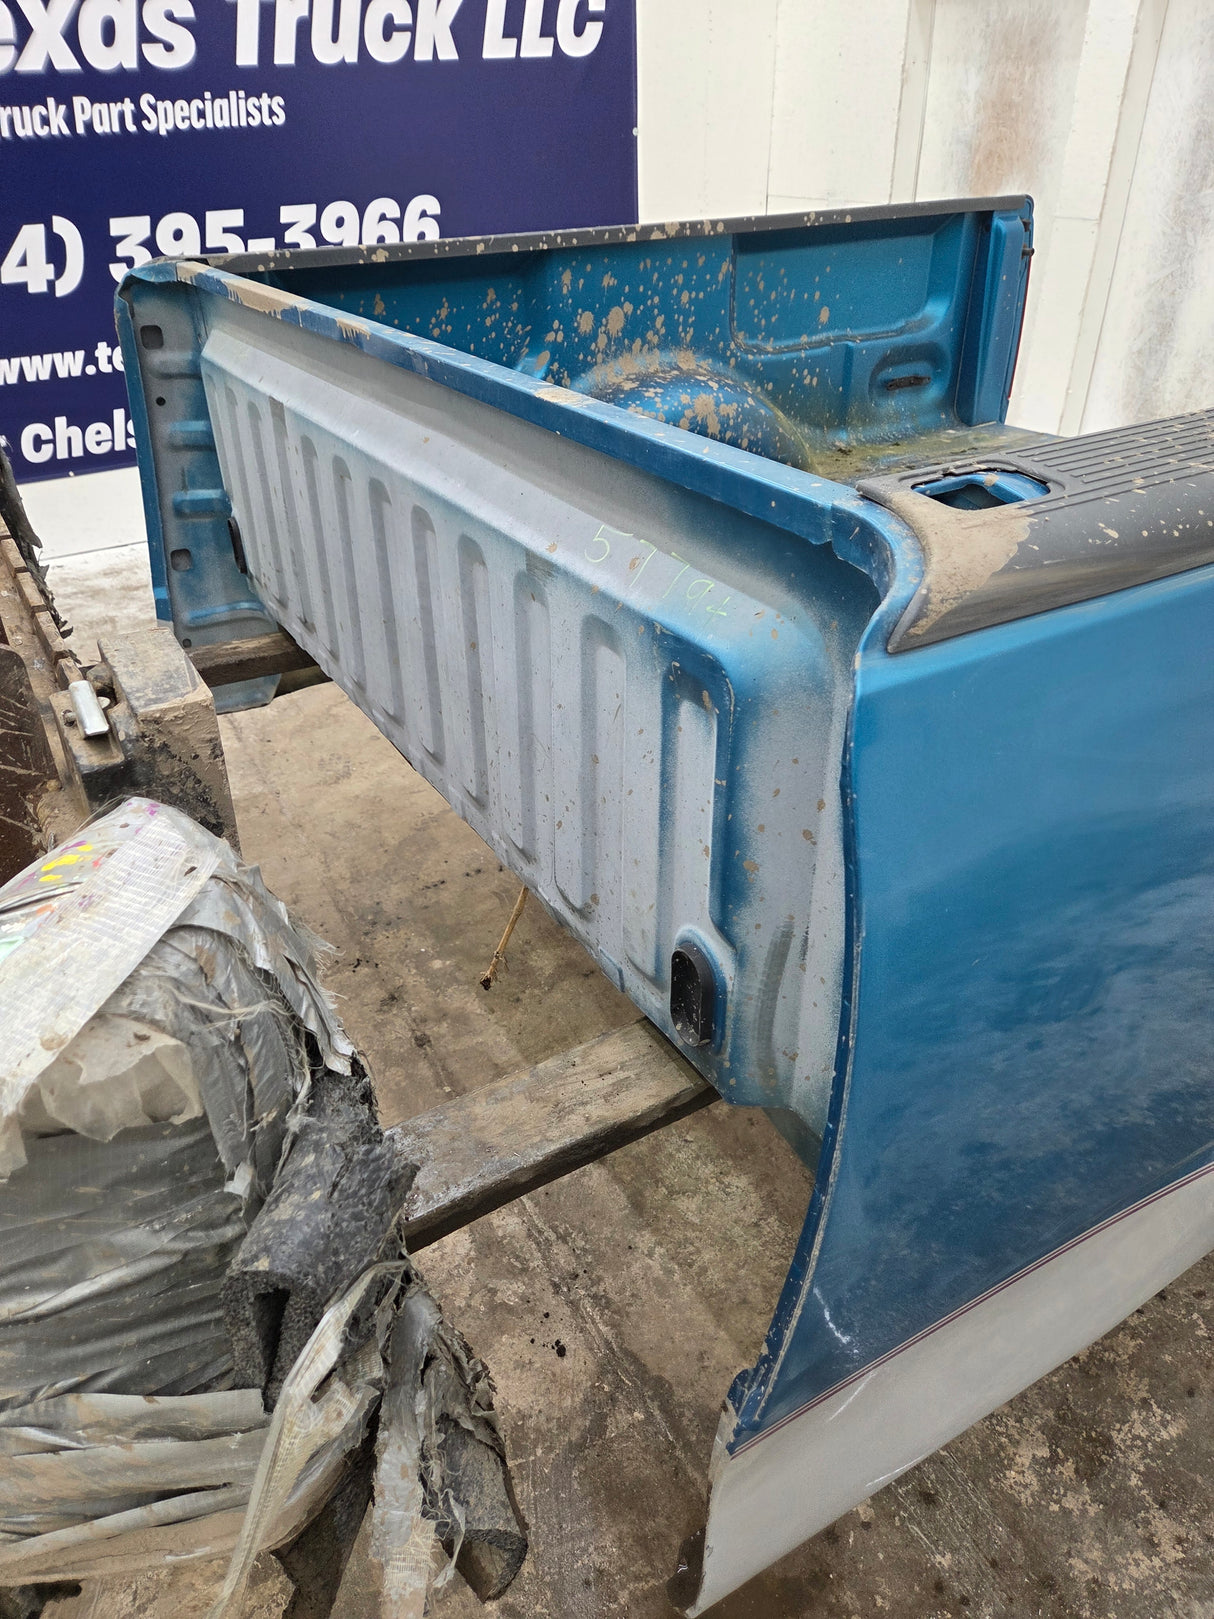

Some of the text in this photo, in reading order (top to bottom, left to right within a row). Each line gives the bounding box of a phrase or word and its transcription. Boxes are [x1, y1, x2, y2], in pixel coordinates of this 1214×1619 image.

[229, 0, 459, 66] Truck
[482, 0, 605, 59] LLC
[72, 95, 136, 134] Part
[140, 90, 286, 136] Specialists
[108, 194, 442, 284] 395-3966
